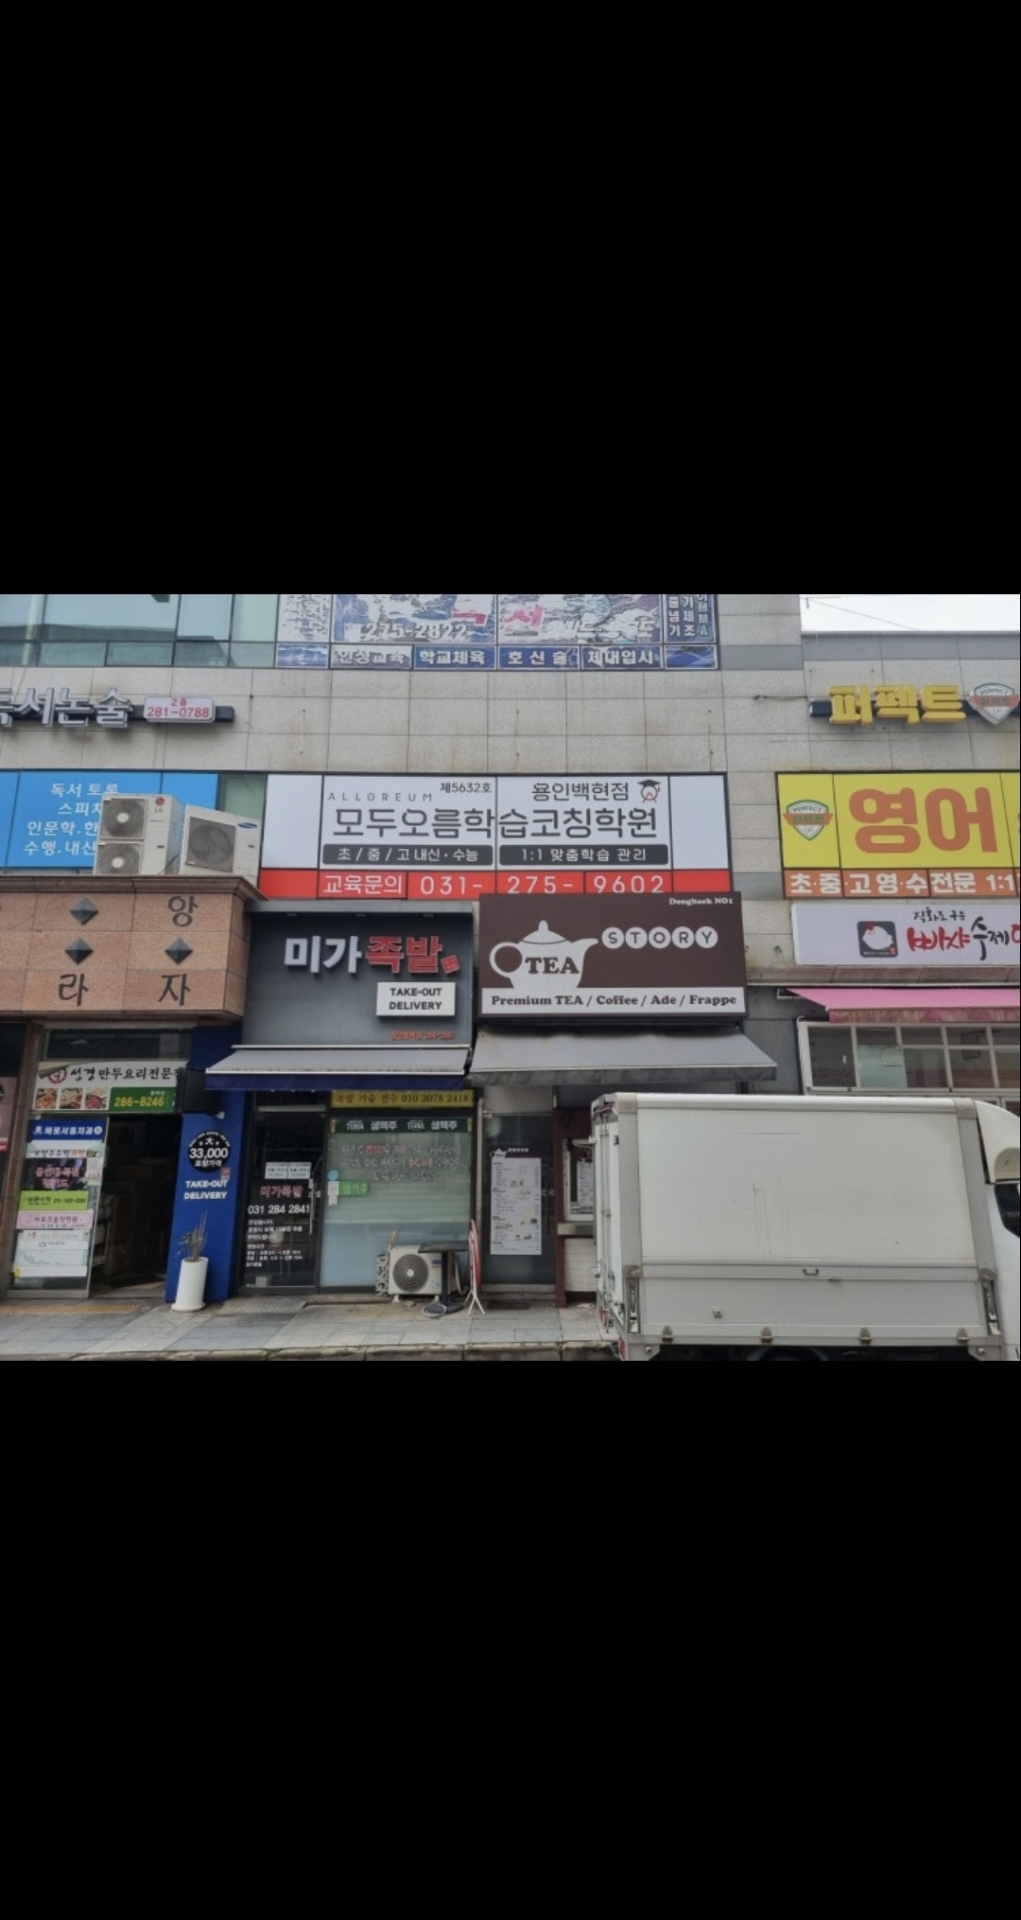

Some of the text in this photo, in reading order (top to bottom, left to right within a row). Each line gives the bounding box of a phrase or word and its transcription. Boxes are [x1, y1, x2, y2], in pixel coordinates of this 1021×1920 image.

[828, 684, 967, 725] 퍼펙트
[147, 706, 209, 718] 281-0788
[50, 783, 82, 798] 독서
[440, 782, 492, 793] 제5632호
[532, 782, 629, 801] 용인백현점
[328, 792, 432, 801] ALLOREUM
[333, 808, 657, 838] 모두오름학습코칭학원
[849, 787, 998, 854] 영어
[522, 848, 646, 862] 1:1 맞춤학습 관리
[323, 874, 402, 895] 교육문의
[594, 875, 663, 894] 9602
[669, 897, 713, 906] Dongbaek
[607, 931, 713, 944] STORY
[525, 957, 580, 974] TEA
[389, 988, 442, 996] TAKE-OUT
[389, 1001, 442, 1010] DELIVERY
[491, 995, 552, 1005] Premium
[555, 995, 583, 1005] TEA
[596, 995, 638, 1005] Coffee
[651, 995, 677, 1005] Ade
[689, 994, 736, 1007] Frappe
[114, 1096, 165, 1107] 286-8246
[401, 1093, 418, 1103] 010
[447, 1093, 469, 1103] 2418
[189, 1147, 229, 1160] 33,000
[185, 1180, 228, 1188] TAKE-OUT
[183, 1191, 228, 1199] DELIVERY
[247, 1204, 310, 1214] 031 284 2841
